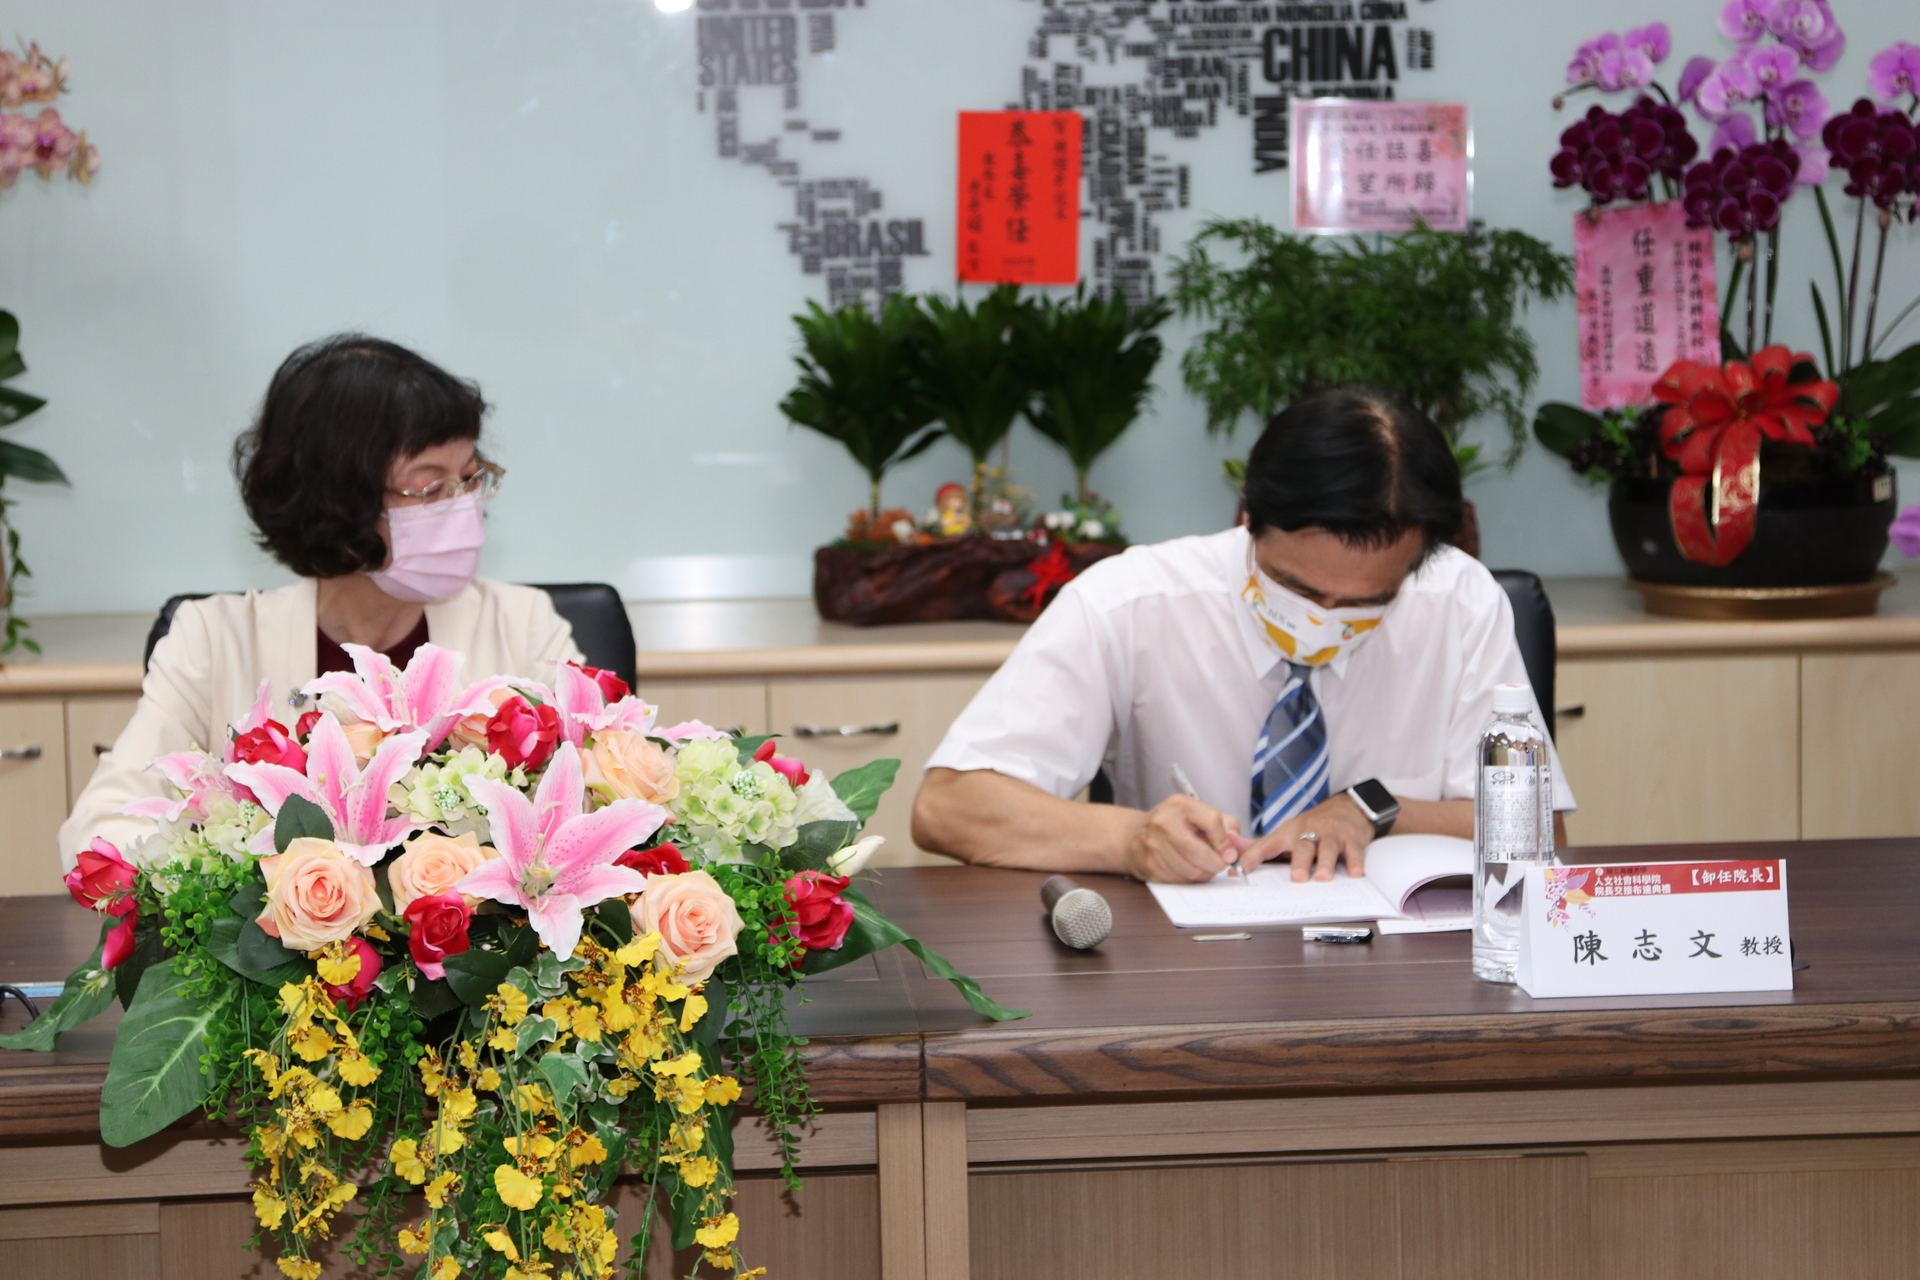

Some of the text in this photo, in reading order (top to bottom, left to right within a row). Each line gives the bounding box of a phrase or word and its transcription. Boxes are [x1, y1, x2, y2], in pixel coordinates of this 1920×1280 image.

[699, 50, 798, 86] STATES
[1263, 25, 1398, 83] CHINA
[1254, 97, 1287, 173] INDIA
[1334, 170, 1436, 196] 望所歸
[822, 219, 932, 259] BRASIL
[1632, 226, 1658, 373] 任重道遠
[1594, 874, 1662, 887] 人文社會科學院
[1594, 884, 1672, 897] 院長交接布達典禮
[1740, 935, 1785, 957] 教授
